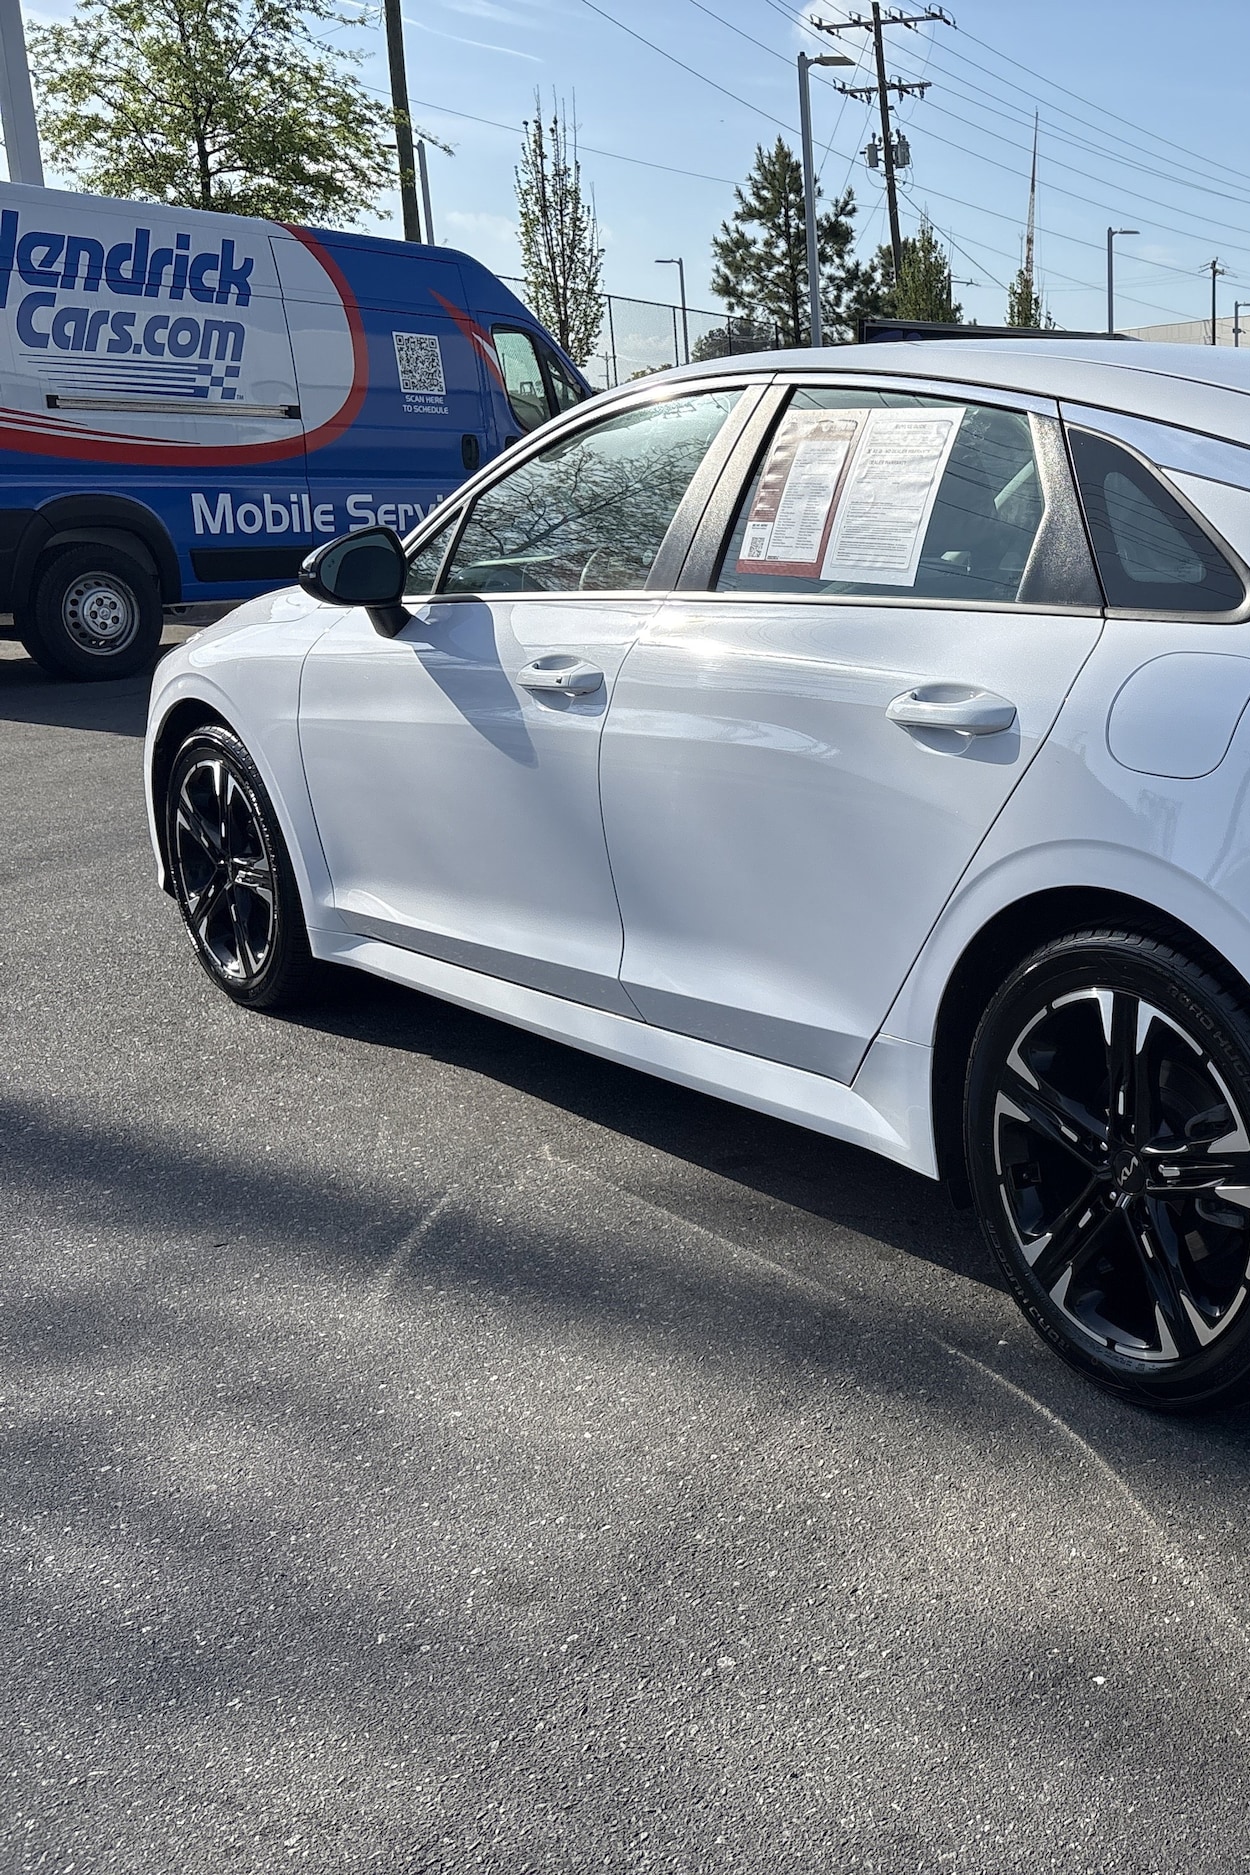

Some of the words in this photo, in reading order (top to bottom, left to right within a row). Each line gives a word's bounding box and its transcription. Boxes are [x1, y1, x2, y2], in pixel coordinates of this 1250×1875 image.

[16, 291, 245, 361] Cars.com
[402, 404, 413, 412] TO
[413, 405, 449, 414] SCHEDULE
[405, 394, 425, 403] SCAN
[425, 396, 444, 404] HERE
[191, 493, 335, 534] Mobile
[1116, 1156, 1139, 1187] KIA
